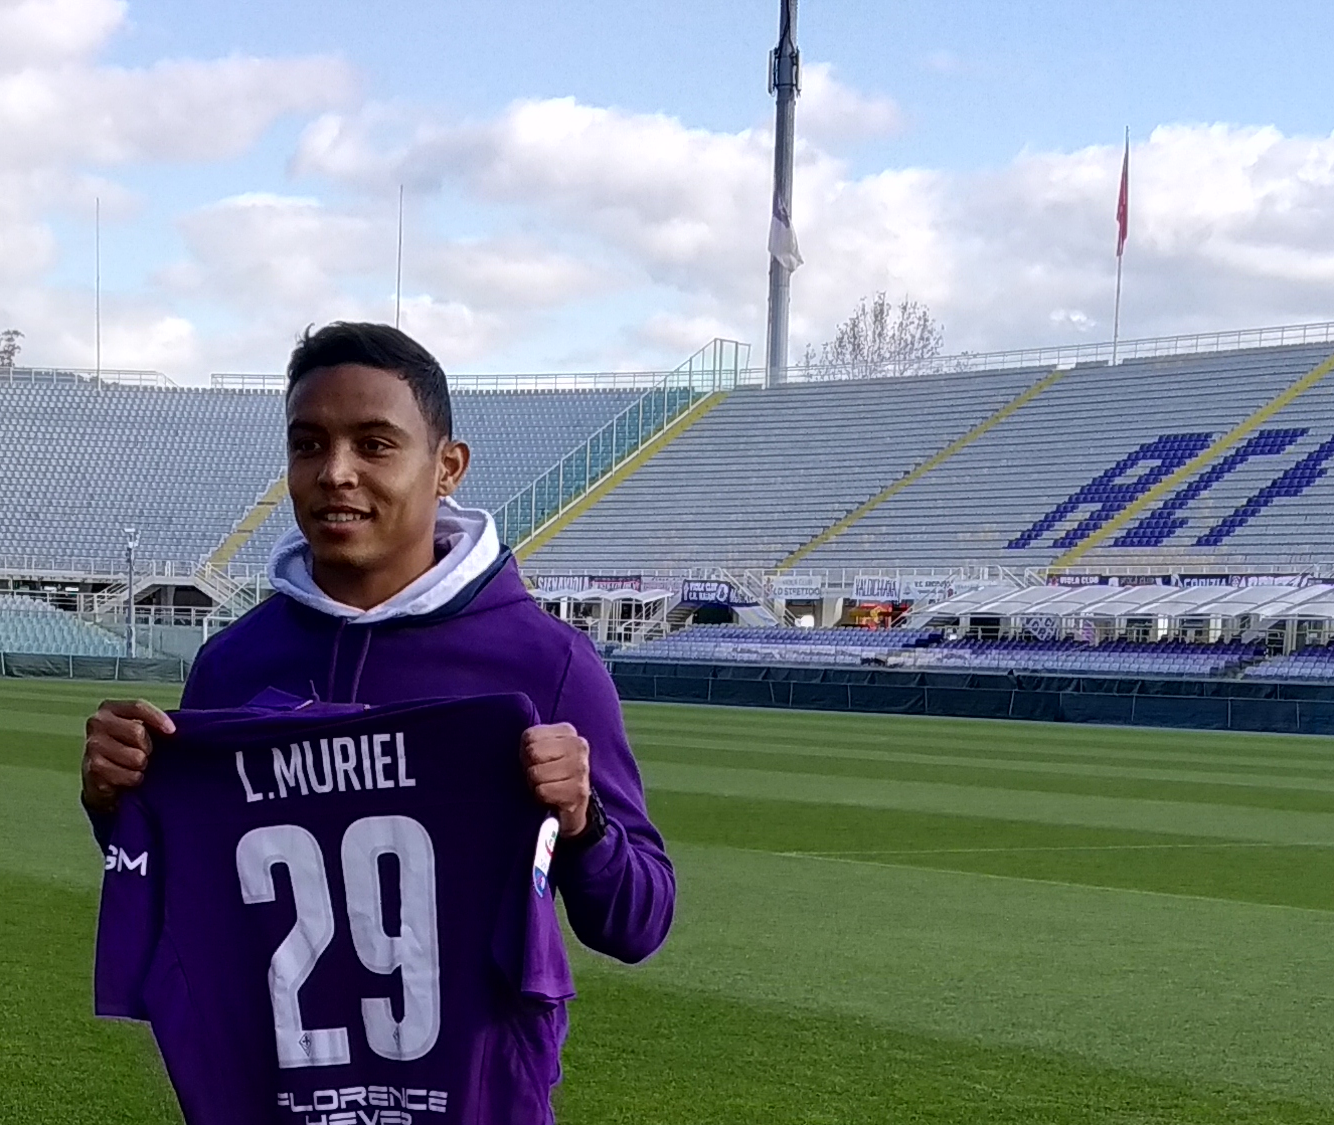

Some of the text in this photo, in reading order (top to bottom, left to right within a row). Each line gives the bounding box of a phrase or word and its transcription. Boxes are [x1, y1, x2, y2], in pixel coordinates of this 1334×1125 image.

[235, 731, 417, 802] L.MURIEL
[235, 814, 441, 1069] 29
[277, 1085, 448, 1113] FLORENCE
